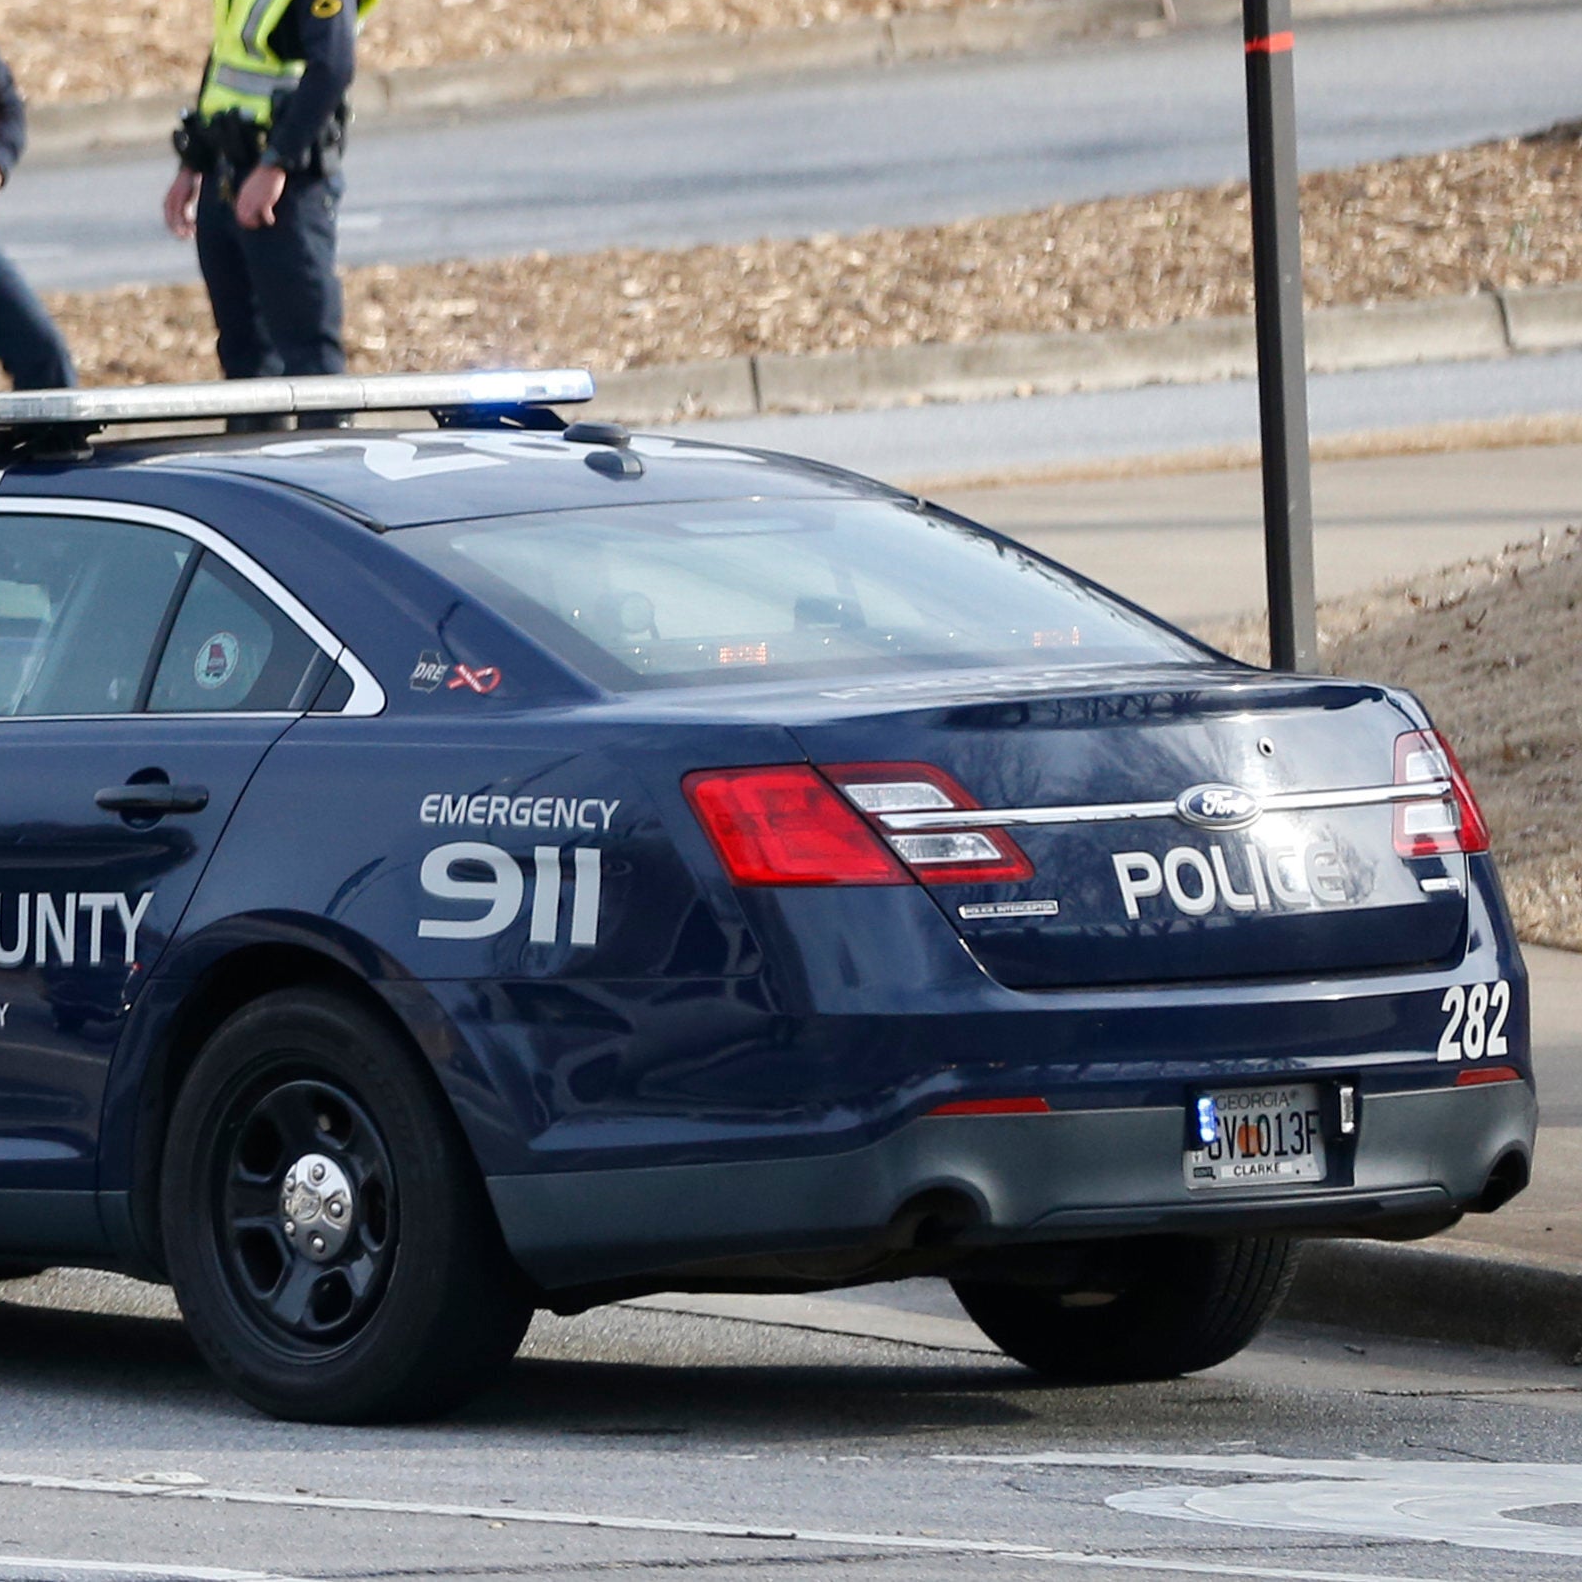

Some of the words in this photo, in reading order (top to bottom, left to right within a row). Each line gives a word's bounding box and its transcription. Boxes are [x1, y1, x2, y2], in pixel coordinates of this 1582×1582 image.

[419, 793, 621, 831] EMERGENCY
[1202, 789, 1255, 816] Ford
[417, 840, 602, 947] 911
[1111, 840, 1350, 919] POLICE
[1437, 979, 1510, 1064] 282
[1215, 1091, 1290, 1111] GEORGIA
[1233, 1162, 1281, 1177] CLARKE
